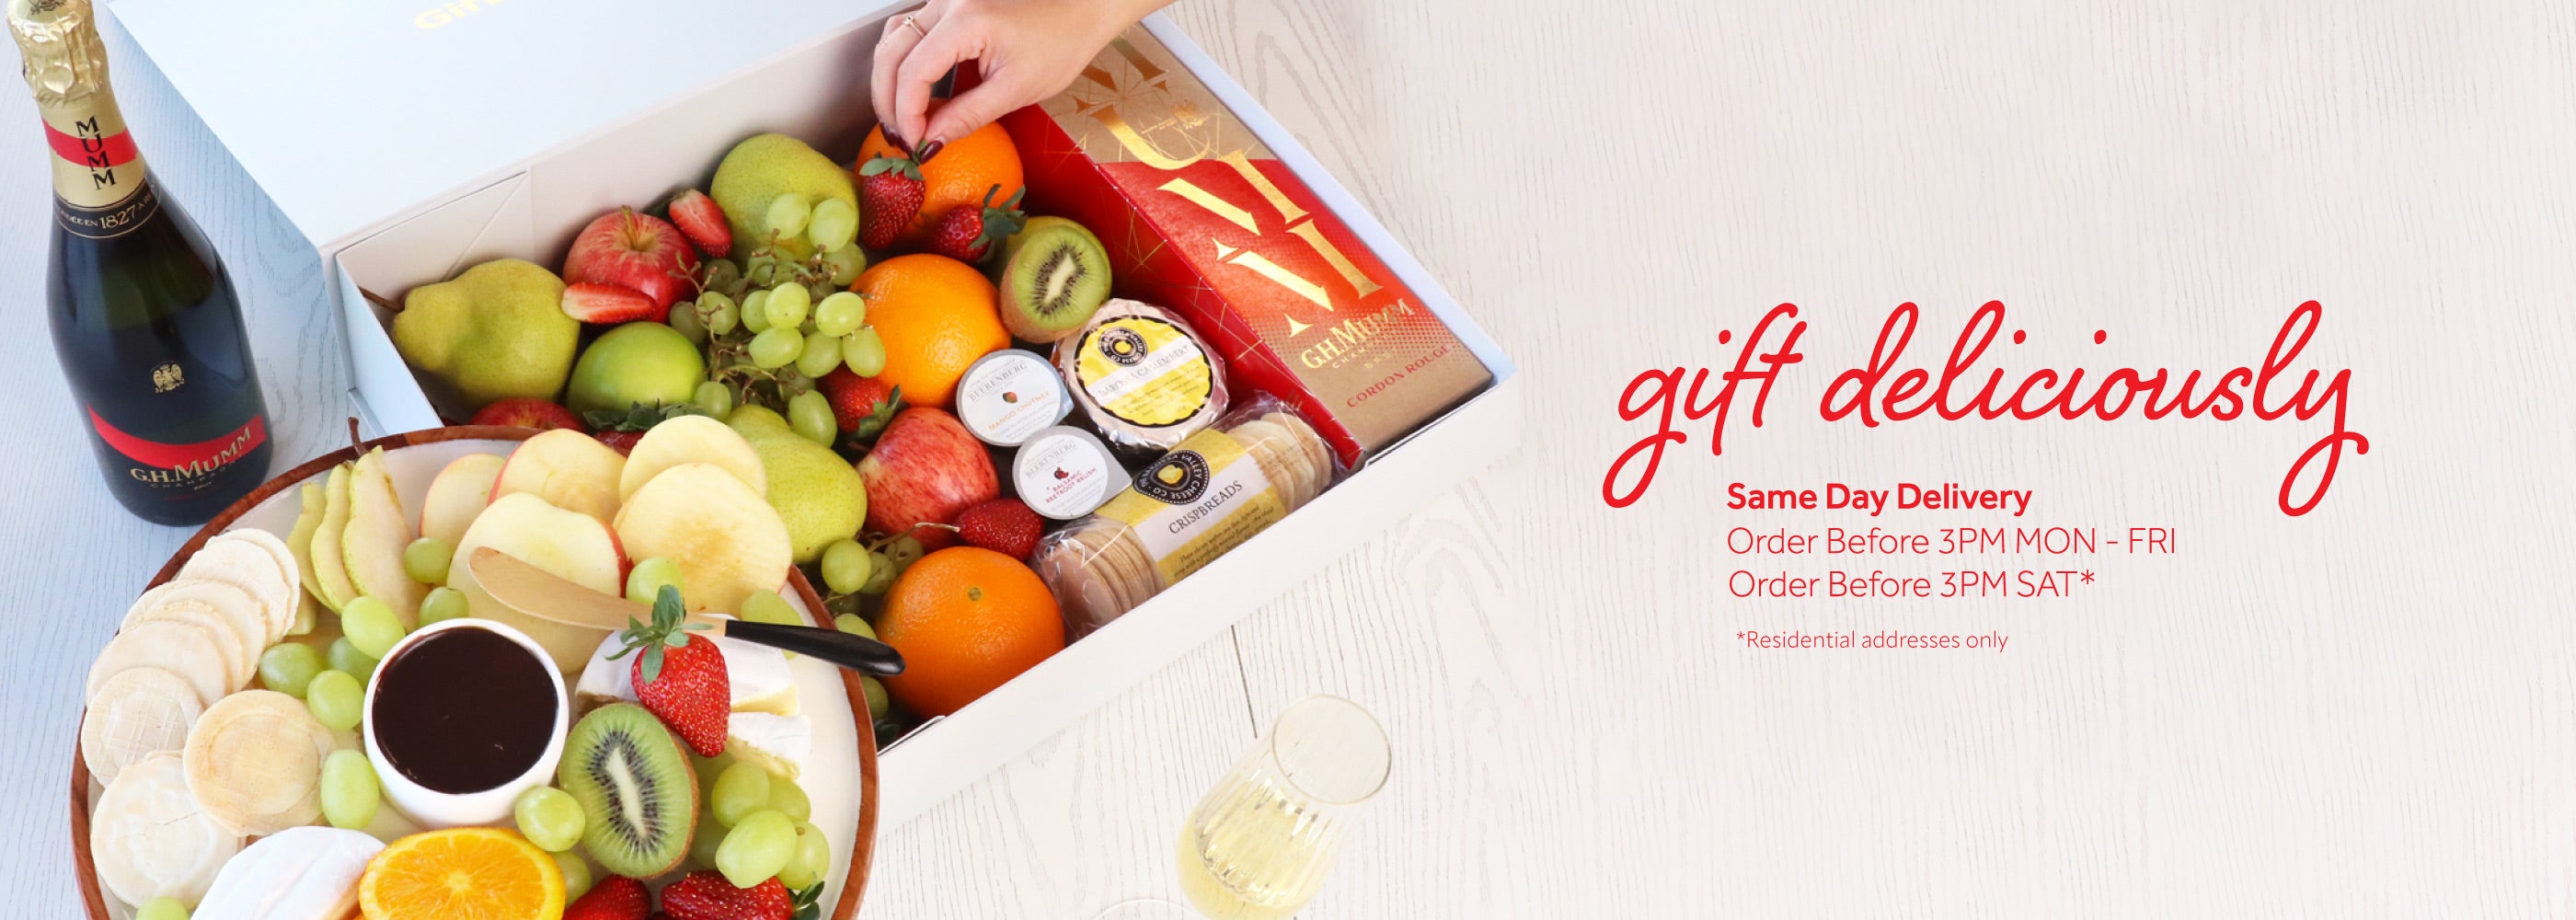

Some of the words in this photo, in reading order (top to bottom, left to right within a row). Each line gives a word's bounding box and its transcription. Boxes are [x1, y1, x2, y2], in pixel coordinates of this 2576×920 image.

[75, 115, 116, 190] MUMM
[99, 204, 136, 229] 1827
[968, 362, 1029, 401] BEERENBERG
[1347, 372, 1406, 408] CORDON
[1405, 345, 1451, 374] ROUGE
[988, 409, 1017, 431] MANGO
[1017, 390, 1051, 412] CHUTNEY
[1052, 470, 1083, 492] BALSAMIC
[1170, 480, 1202, 500] CHEESE
[1167, 479, 1244, 535] CRISPBREADS
